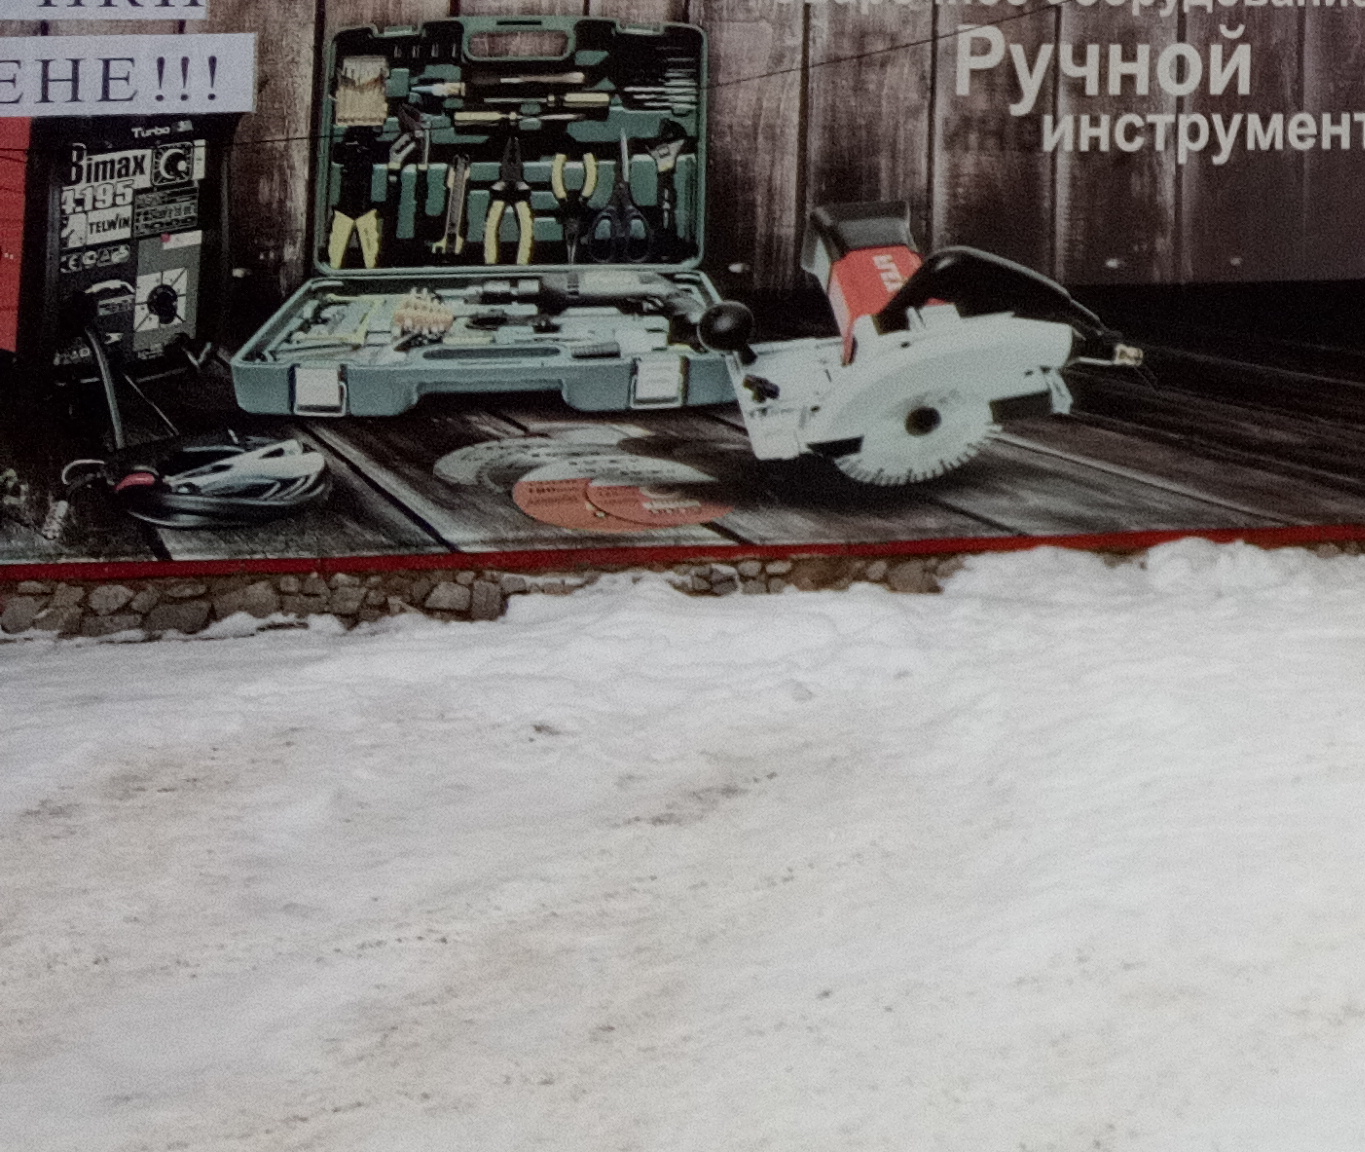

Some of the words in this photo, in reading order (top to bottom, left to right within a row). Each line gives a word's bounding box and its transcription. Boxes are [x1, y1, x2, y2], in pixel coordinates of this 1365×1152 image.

[955, 23, 1252, 116] Ручной
[131, 125, 171, 139] Turbo
[71, 142, 147, 184] Bimax
